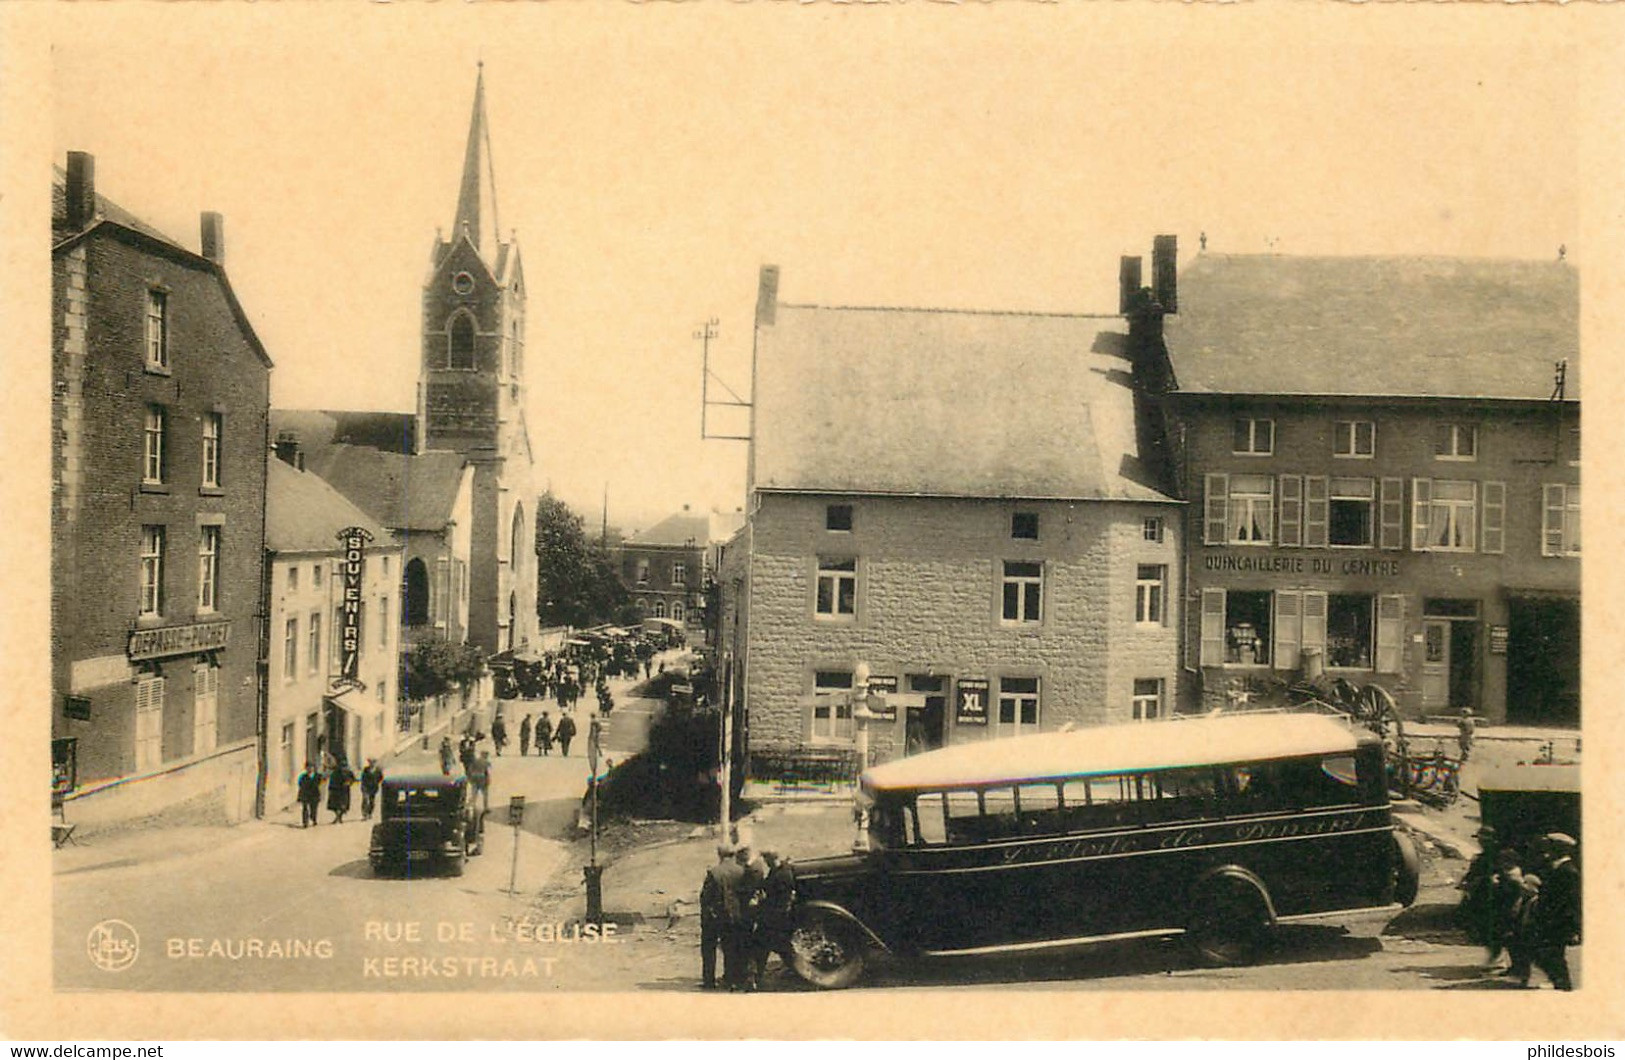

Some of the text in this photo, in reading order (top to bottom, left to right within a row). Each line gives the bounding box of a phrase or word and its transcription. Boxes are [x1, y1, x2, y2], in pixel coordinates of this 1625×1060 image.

[1205, 556, 1400, 575] QUINCAILLERIE DU CENTRE
[963, 693, 983, 711] XL
